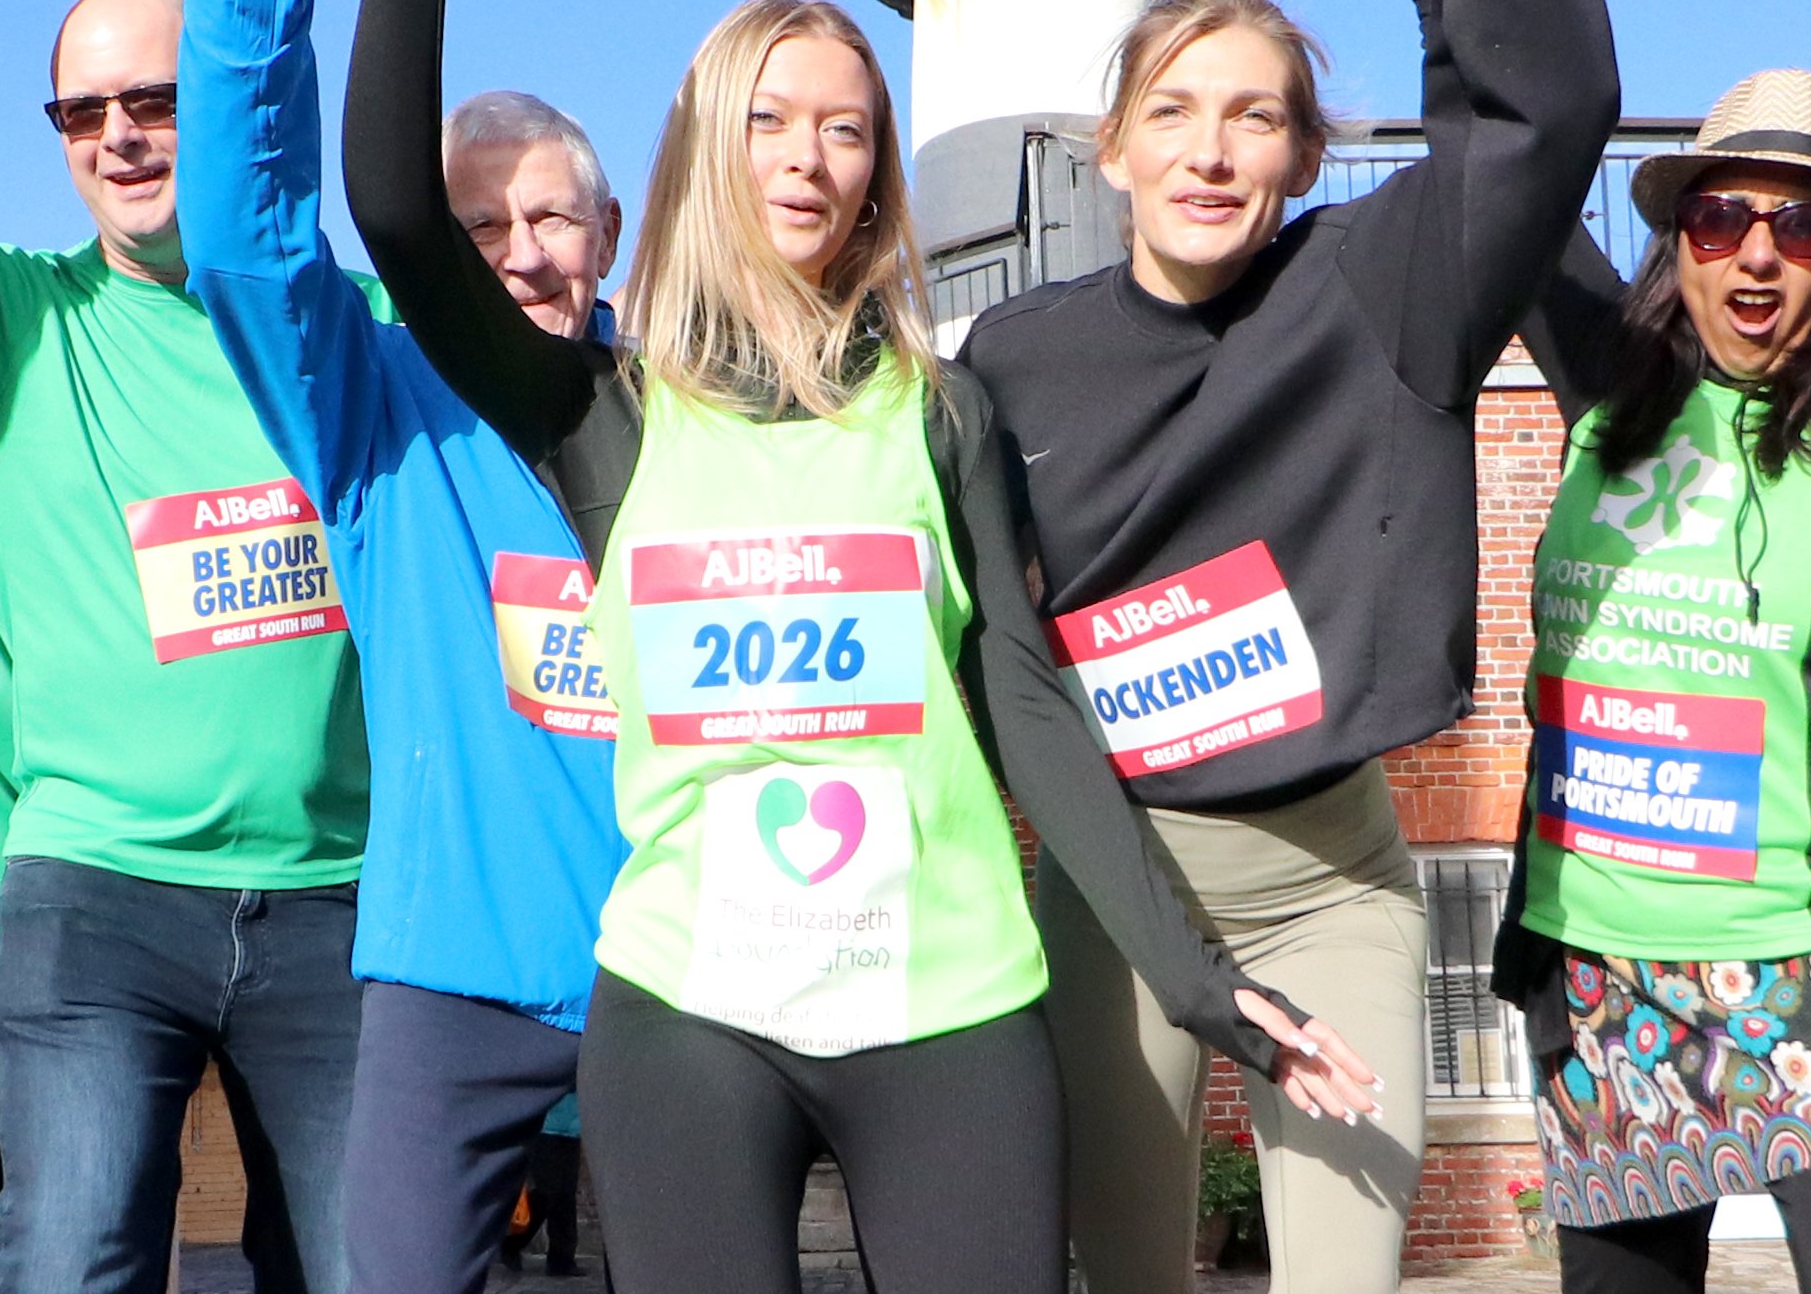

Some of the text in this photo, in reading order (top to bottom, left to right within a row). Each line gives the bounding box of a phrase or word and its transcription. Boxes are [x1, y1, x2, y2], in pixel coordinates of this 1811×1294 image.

[193, 534, 319, 582] BE YOUR
[193, 567, 328, 617] GREATEST
[212, 613, 326, 646] GREAT SOUTH RUN
[541, 623, 587, 659] BE
[1598, 601, 1795, 651] SYNDROME
[691, 617, 866, 688] 2026
[1093, 627, 1288, 724] OCKENDEN
[1545, 629, 1751, 679] ASSOCIATION
[543, 709, 590, 731] GREAT
[700, 710, 866, 739] GREAT SOUTH RUN
[1142, 707, 1287, 768] GREAT SOUTH RUN
[1573, 746, 1701, 796] PRIDE OF
[1551, 773, 1737, 834] PORTSMOUTH
[1574, 832, 1697, 869] GREAT SOUTH RUN
[772, 905, 891, 932] Elizabeth
[819, 1036, 853, 1050] and
